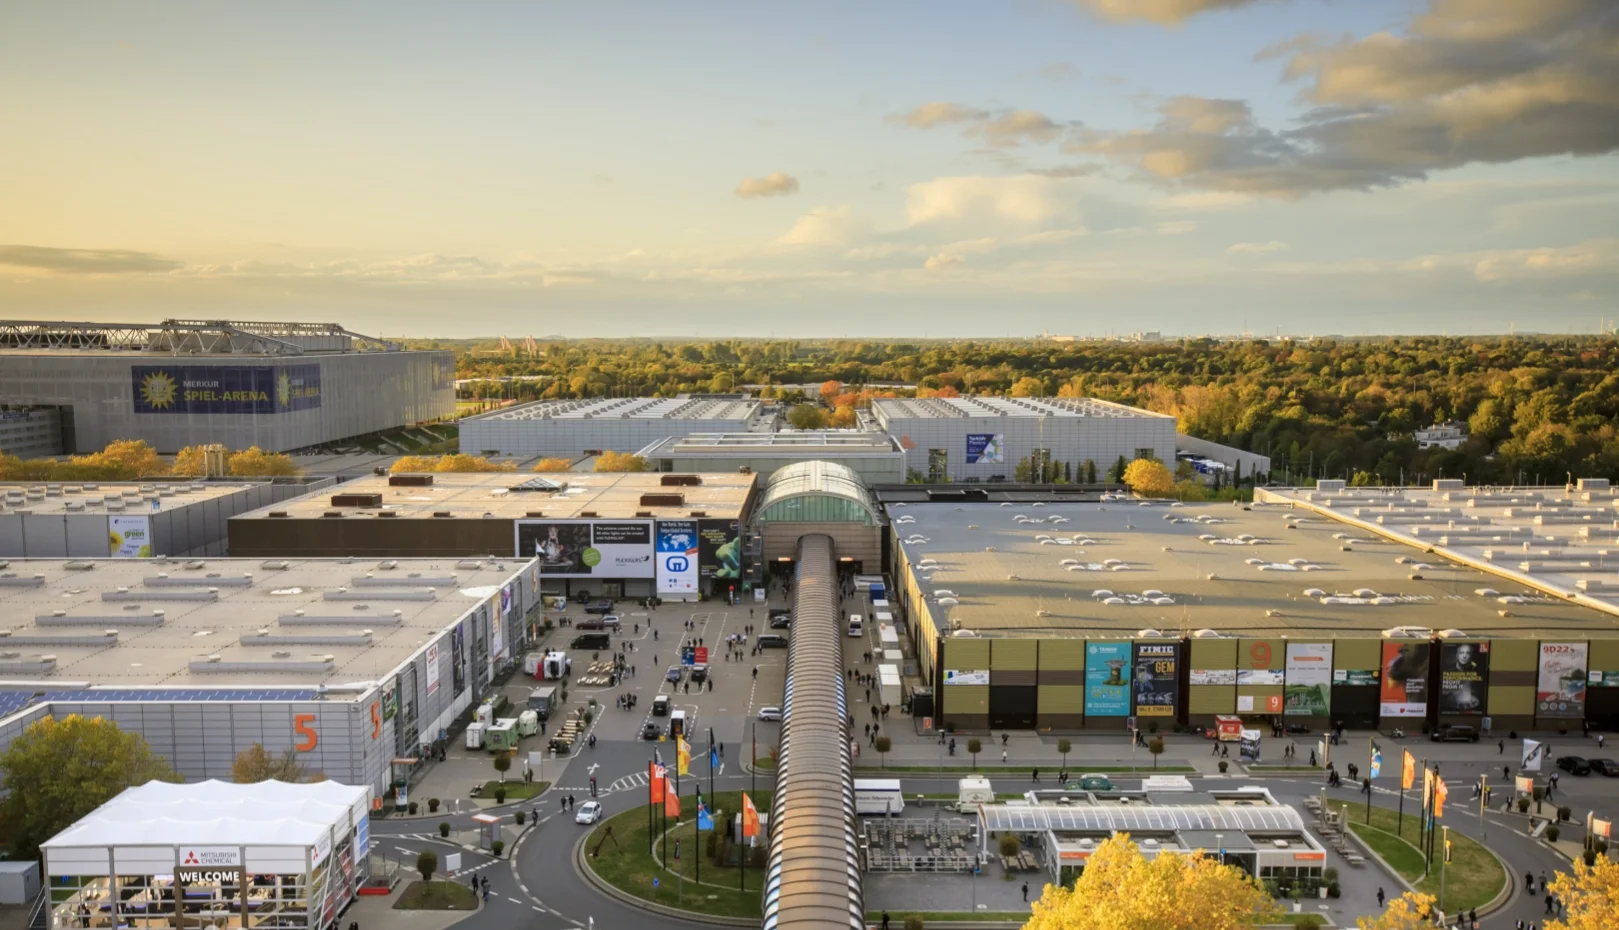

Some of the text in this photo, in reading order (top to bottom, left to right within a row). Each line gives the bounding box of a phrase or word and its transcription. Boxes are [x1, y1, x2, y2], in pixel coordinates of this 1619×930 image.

[183, 380, 219, 388] MERKUR
[184, 390, 268, 401] SPIEL-ARENA
[124, 531, 145, 539] green
[1250, 642, 1272, 670] 9
[1155, 661, 1175, 673] GEM
[1271, 696, 1279, 708] 9
[371, 700, 381, 740] 5
[295, 714, 317, 752] 5
[179, 871, 240, 882] WELCOME
